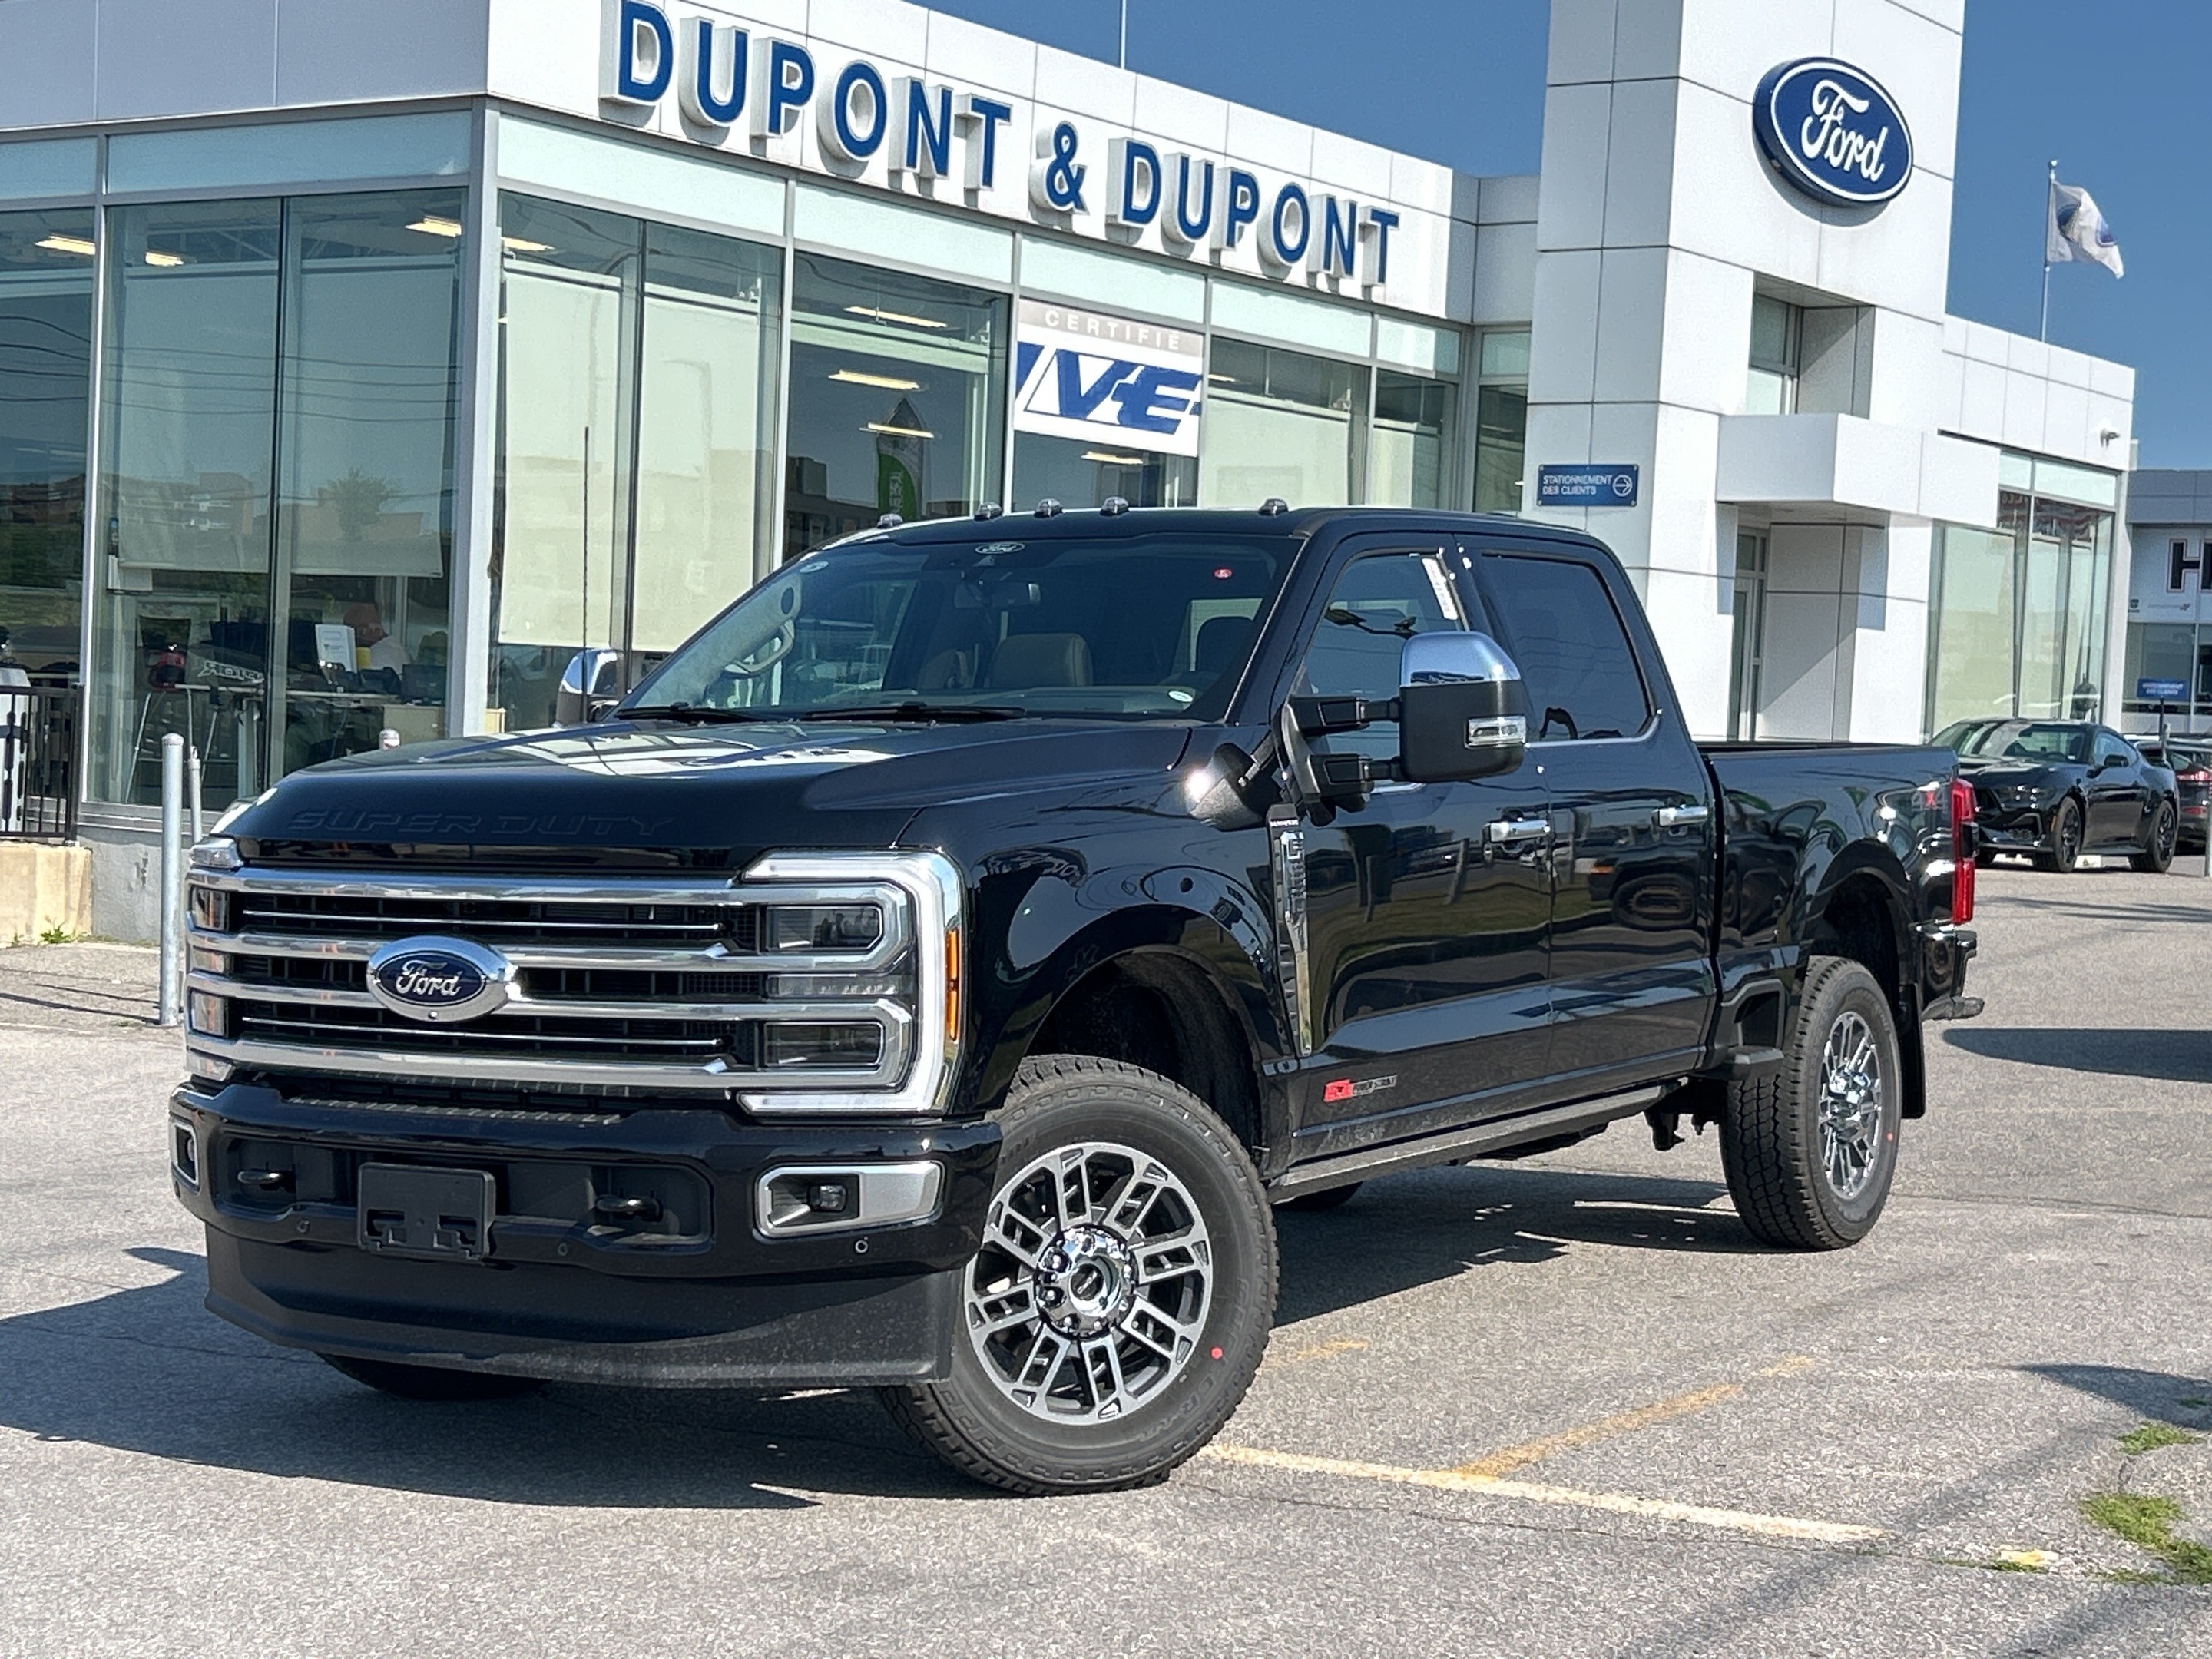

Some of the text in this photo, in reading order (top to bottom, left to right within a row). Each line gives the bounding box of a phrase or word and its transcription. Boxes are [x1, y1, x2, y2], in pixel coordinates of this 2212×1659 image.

[612, 1, 1399, 285] DUPONT & DUPONT
[1801, 79, 1889, 183] Ford
[1045, 309, 1181, 351] CERTIFIÉ
[1541, 485, 1598, 495] DES CLIENTS
[1542, 475, 1613, 485] STATIONNEMENT
[289, 810, 674, 836] SUPER DUTY
[395, 959, 463, 996] Ford
